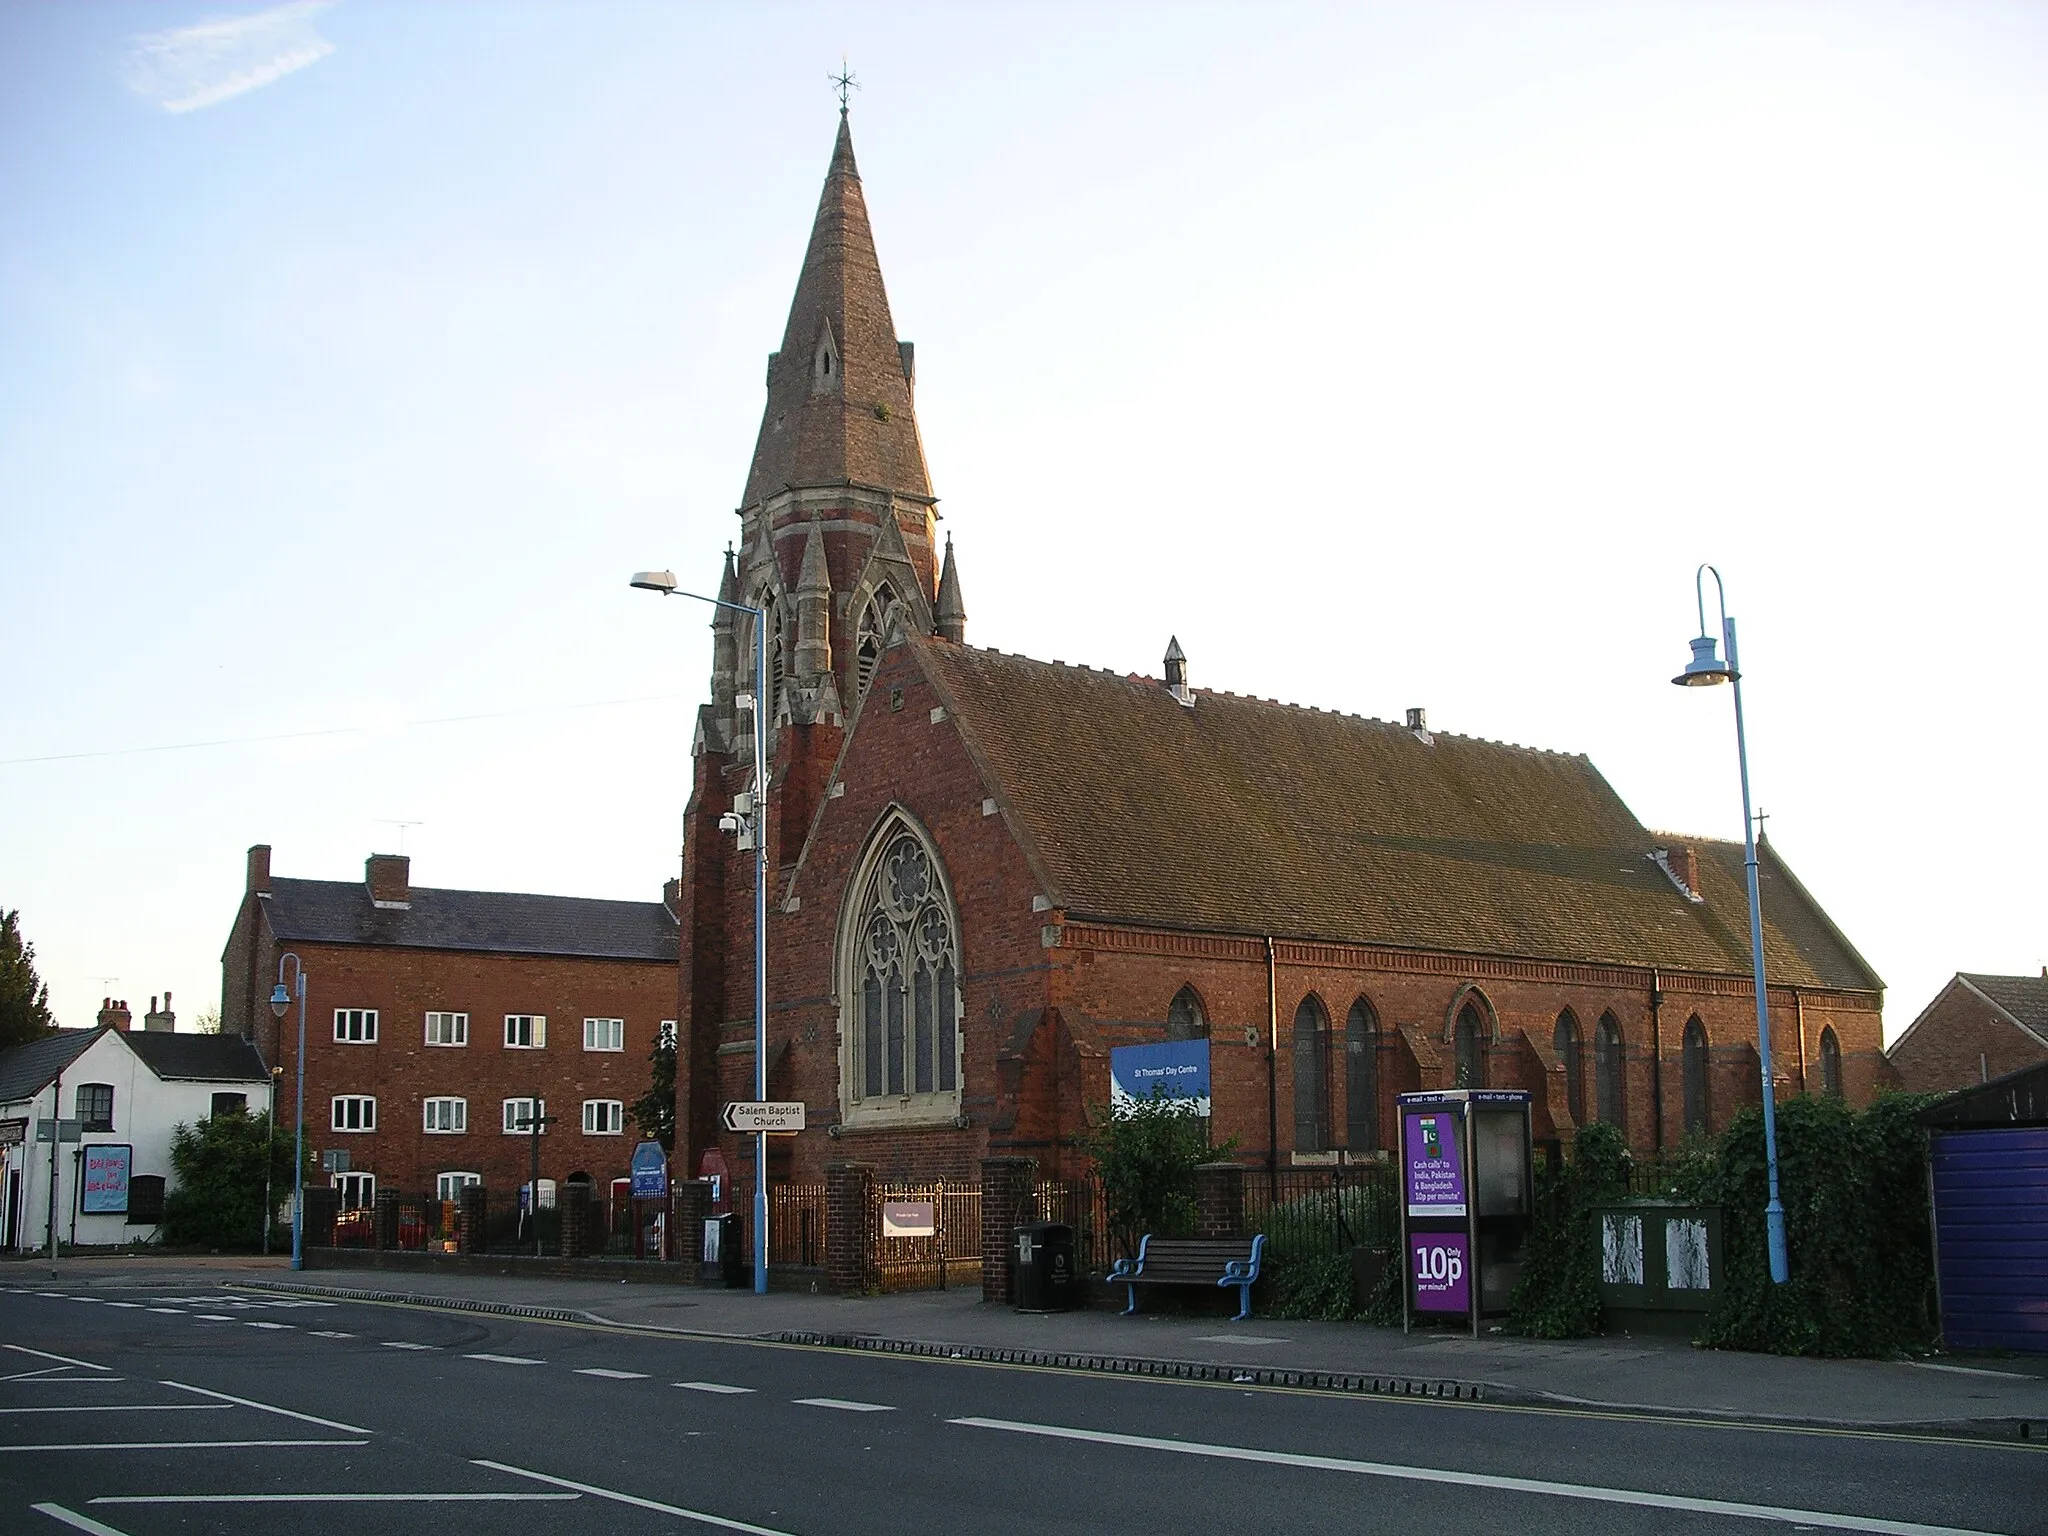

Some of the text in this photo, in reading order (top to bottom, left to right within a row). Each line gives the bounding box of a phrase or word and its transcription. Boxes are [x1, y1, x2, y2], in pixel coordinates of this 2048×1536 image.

[1134, 1070, 1141, 1078] St
[1166, 1067, 1177, 1076] Day
[1178, 1065, 1198, 1074] Centre
[739, 1106, 800, 1115] Salem Baptist
[753, 1117, 786, 1126] Church
[1413, 1161, 1427, 1169] Cash
[1414, 1171, 1456, 1180] India, Pakistan
[1414, 1181, 1454, 1191] & Bangladesh
[1415, 1192, 1426, 1201] 10p
[1447, 1247, 1461, 1257] Only
[1416, 1246, 1462, 1287] 10p
